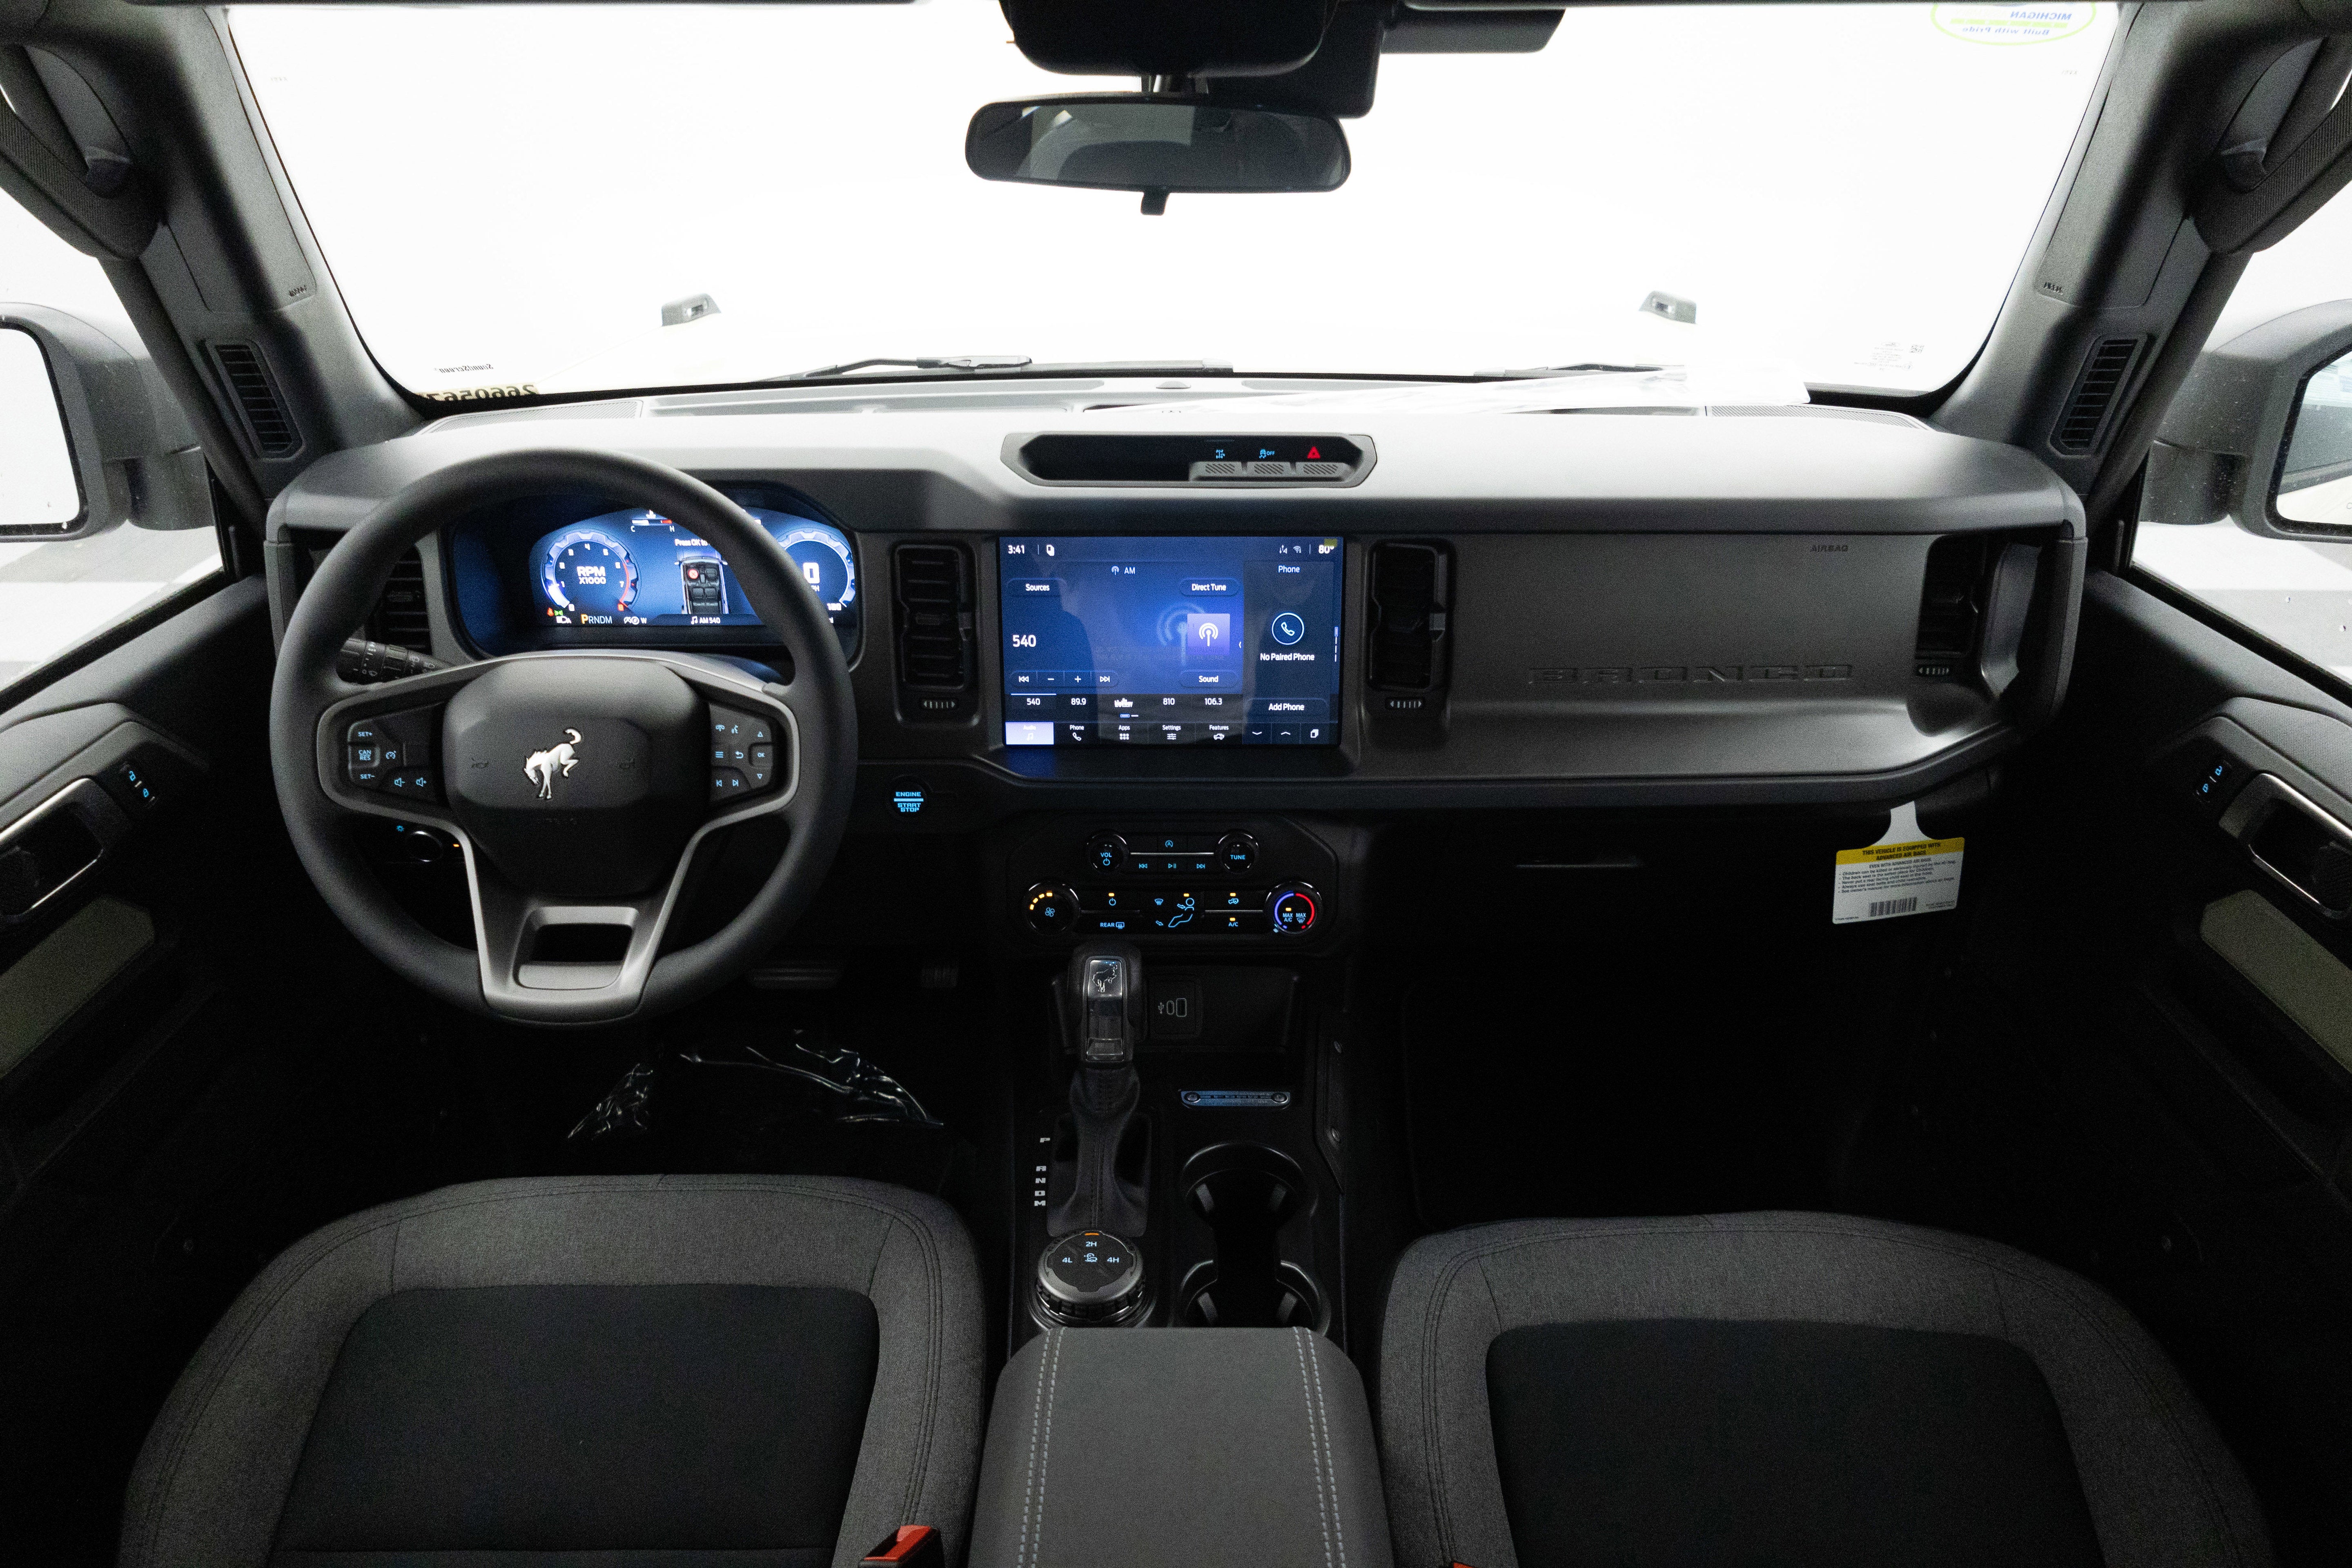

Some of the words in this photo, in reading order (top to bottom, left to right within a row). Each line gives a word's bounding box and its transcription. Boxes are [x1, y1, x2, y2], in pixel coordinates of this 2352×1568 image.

[1008, 545, 1025, 554] 3:41
[577, 566, 606, 577] RPM
[803, 562, 820, 584] 0
[1013, 635, 1036, 647] 540
